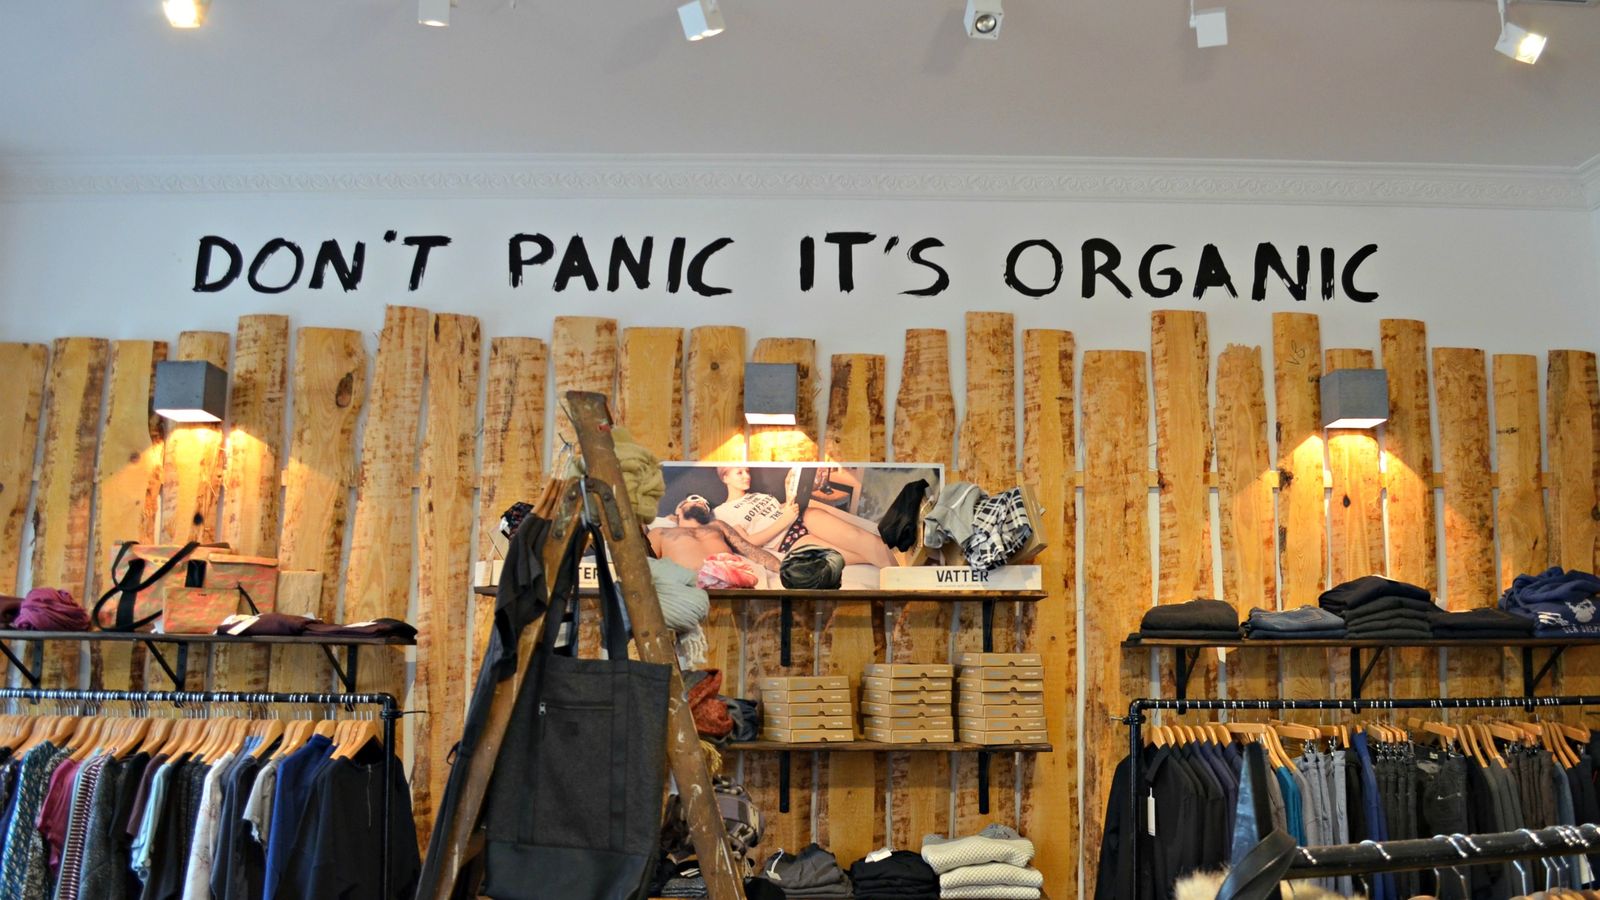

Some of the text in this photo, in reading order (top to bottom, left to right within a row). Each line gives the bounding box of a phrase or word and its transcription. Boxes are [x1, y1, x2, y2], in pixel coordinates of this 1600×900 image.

[192, 231, 1379, 302] DON'T PANIC IT'S ORGANIC
[744, 494, 773, 522] BOYFRIE
[770, 510, 783, 520] THE
[936, 570, 989, 582] VATTER
